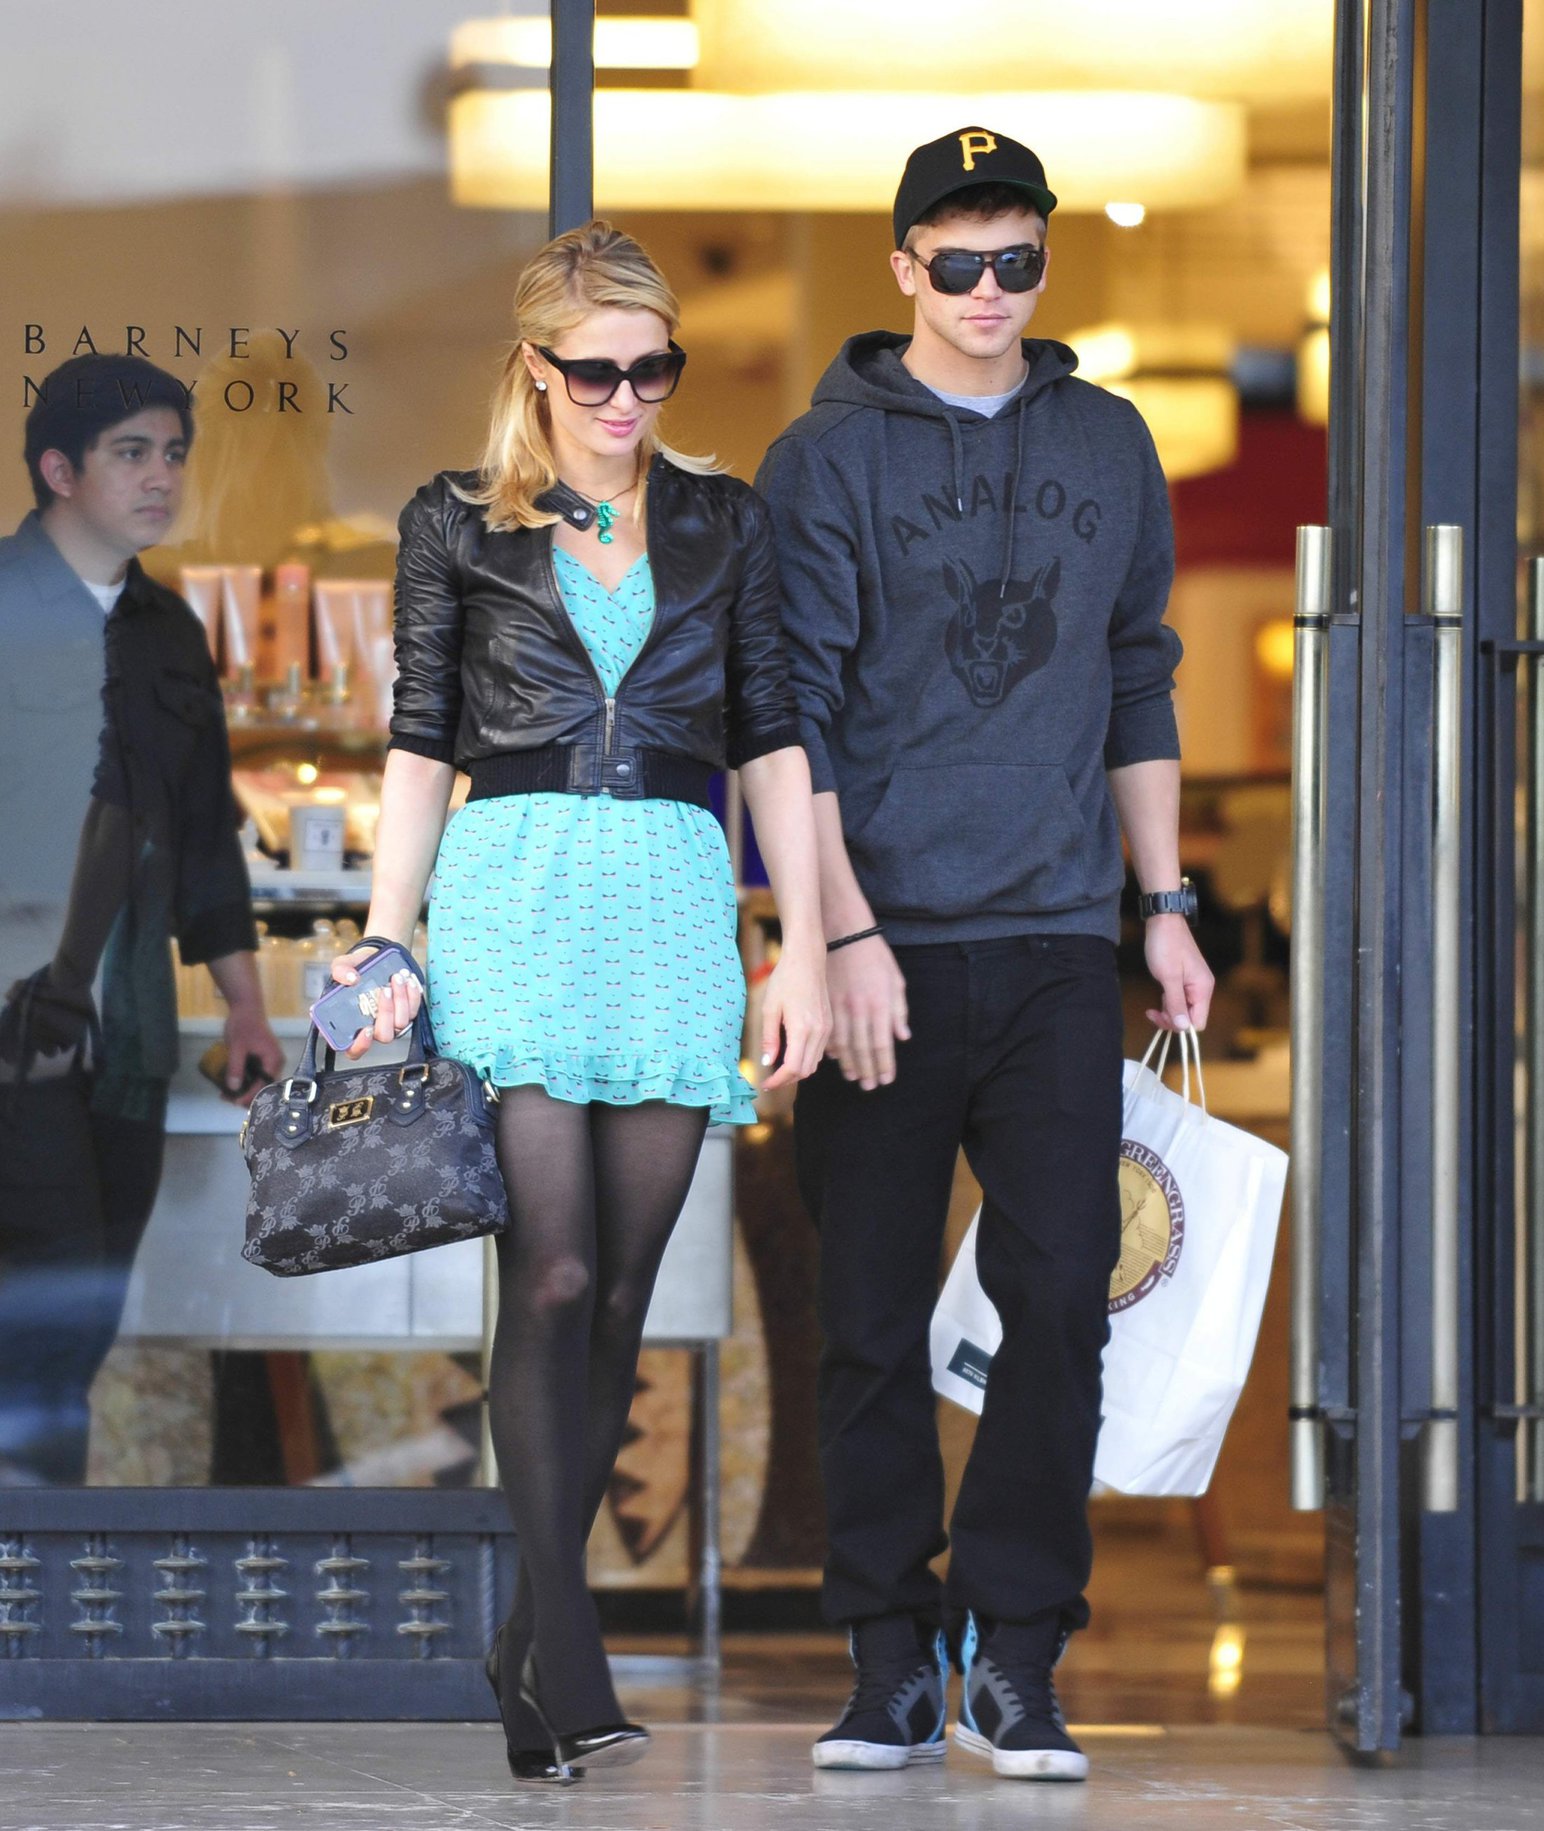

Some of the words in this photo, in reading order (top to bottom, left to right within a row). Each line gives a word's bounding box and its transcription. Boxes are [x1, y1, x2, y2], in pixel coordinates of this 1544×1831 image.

[958, 131, 998, 172] P
[23, 323, 349, 361] BARNEYS
[23, 375, 153, 410] NEW
[178, 378, 355, 414] YORK
[889, 472, 1102, 557] ANALOG
[1120, 1140, 1184, 1275] GREENGRASS
